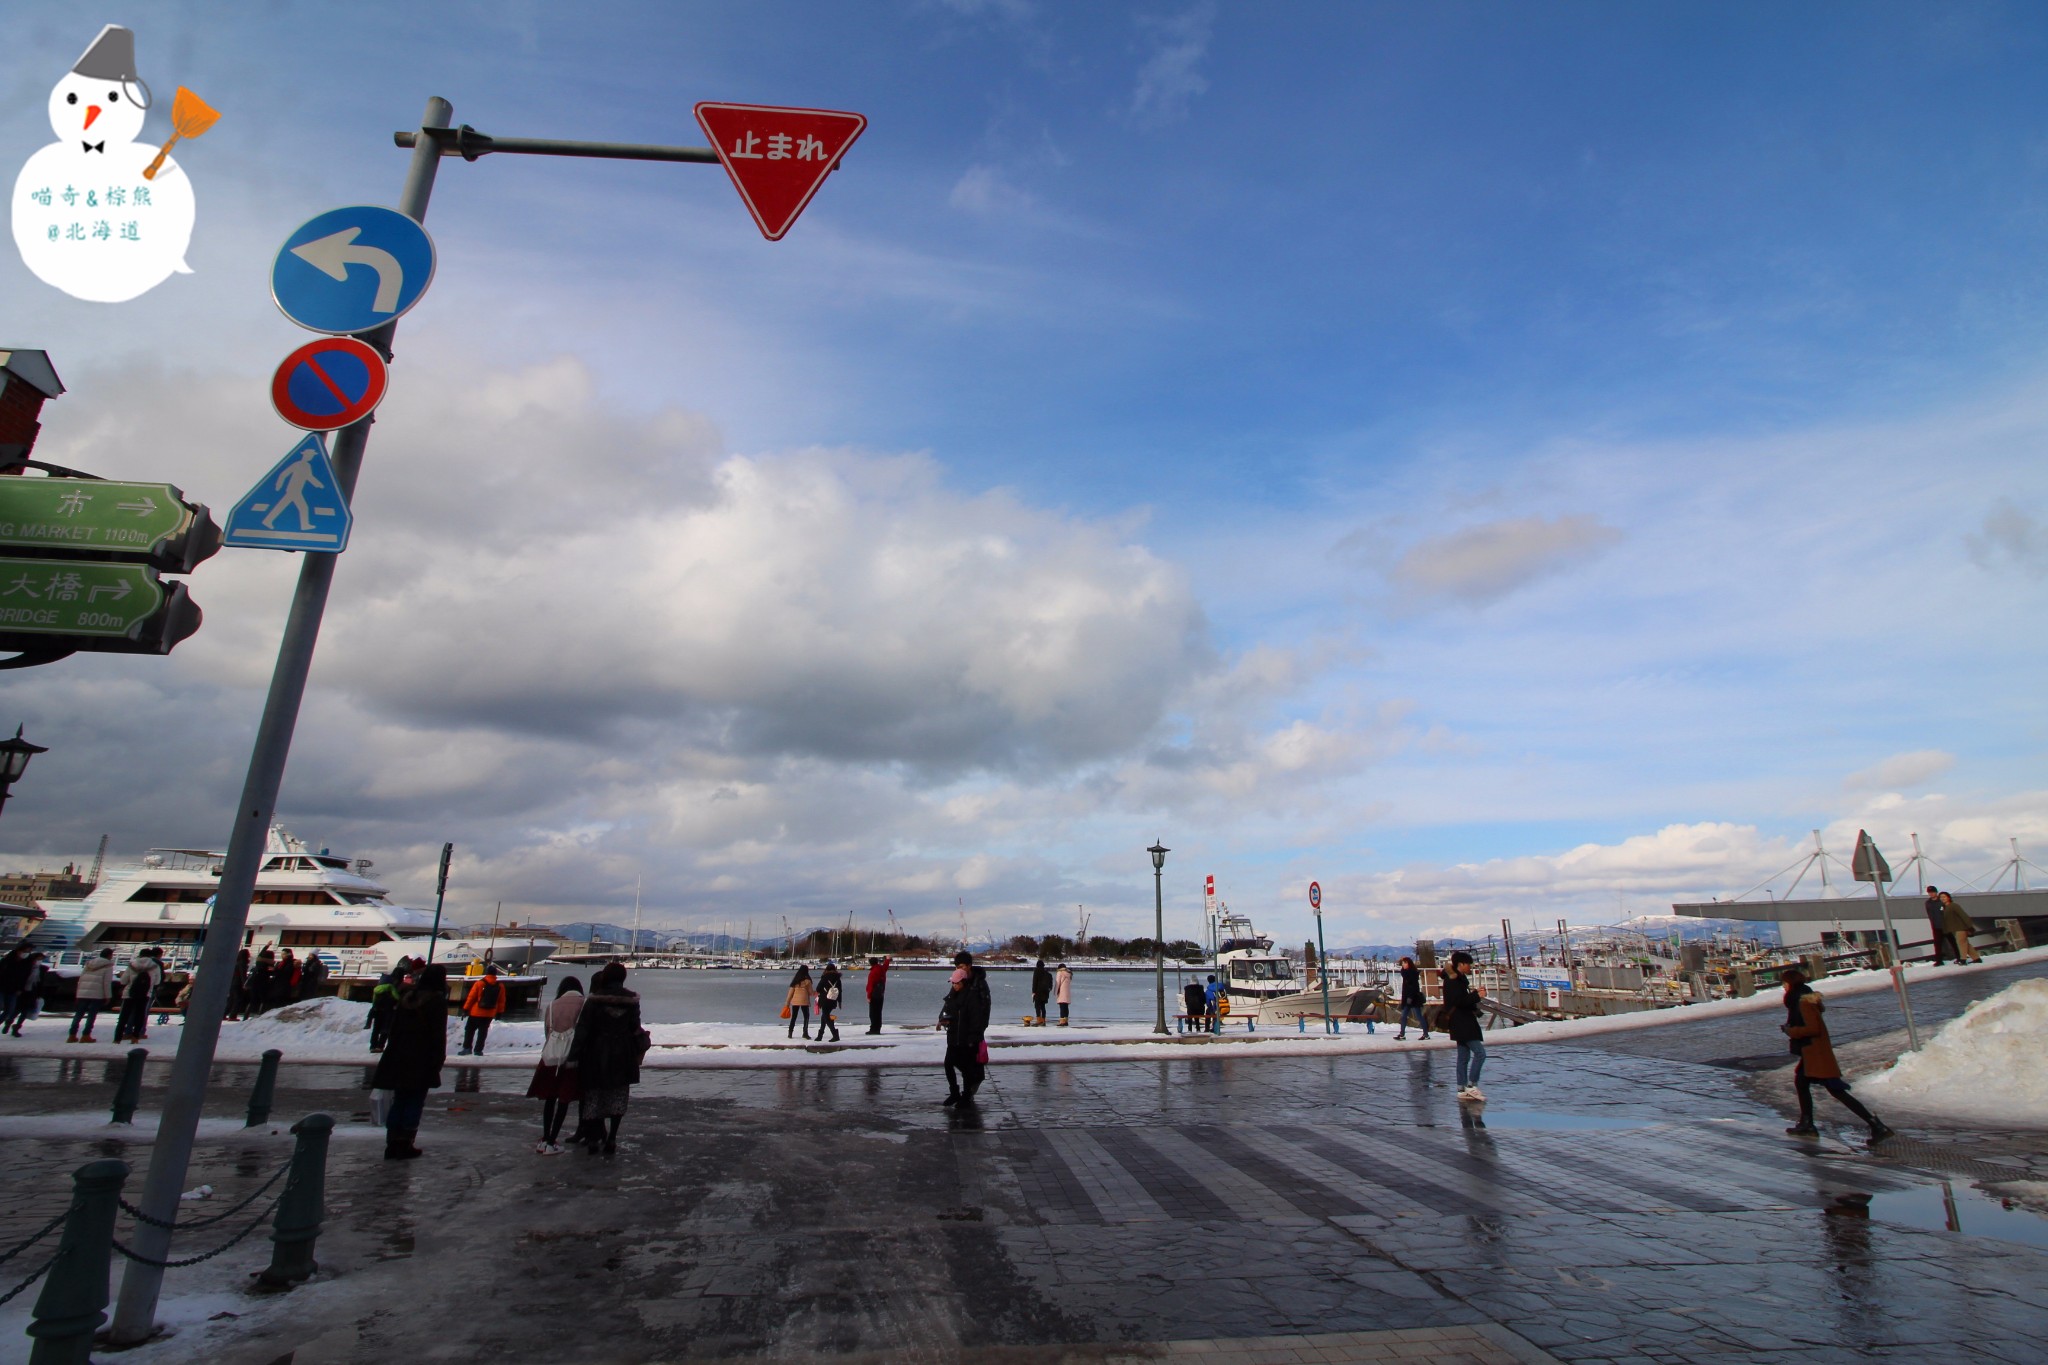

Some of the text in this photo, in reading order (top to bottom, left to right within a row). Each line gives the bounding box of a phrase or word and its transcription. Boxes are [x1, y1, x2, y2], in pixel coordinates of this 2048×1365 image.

[729, 130, 828, 162] 止まれ
[56, 489, 94, 518] 市
[0, 521, 149, 544] G MARKET 1100m
[2, 571, 84, 601] 大橋
[77, 612, 124, 627] 800m
